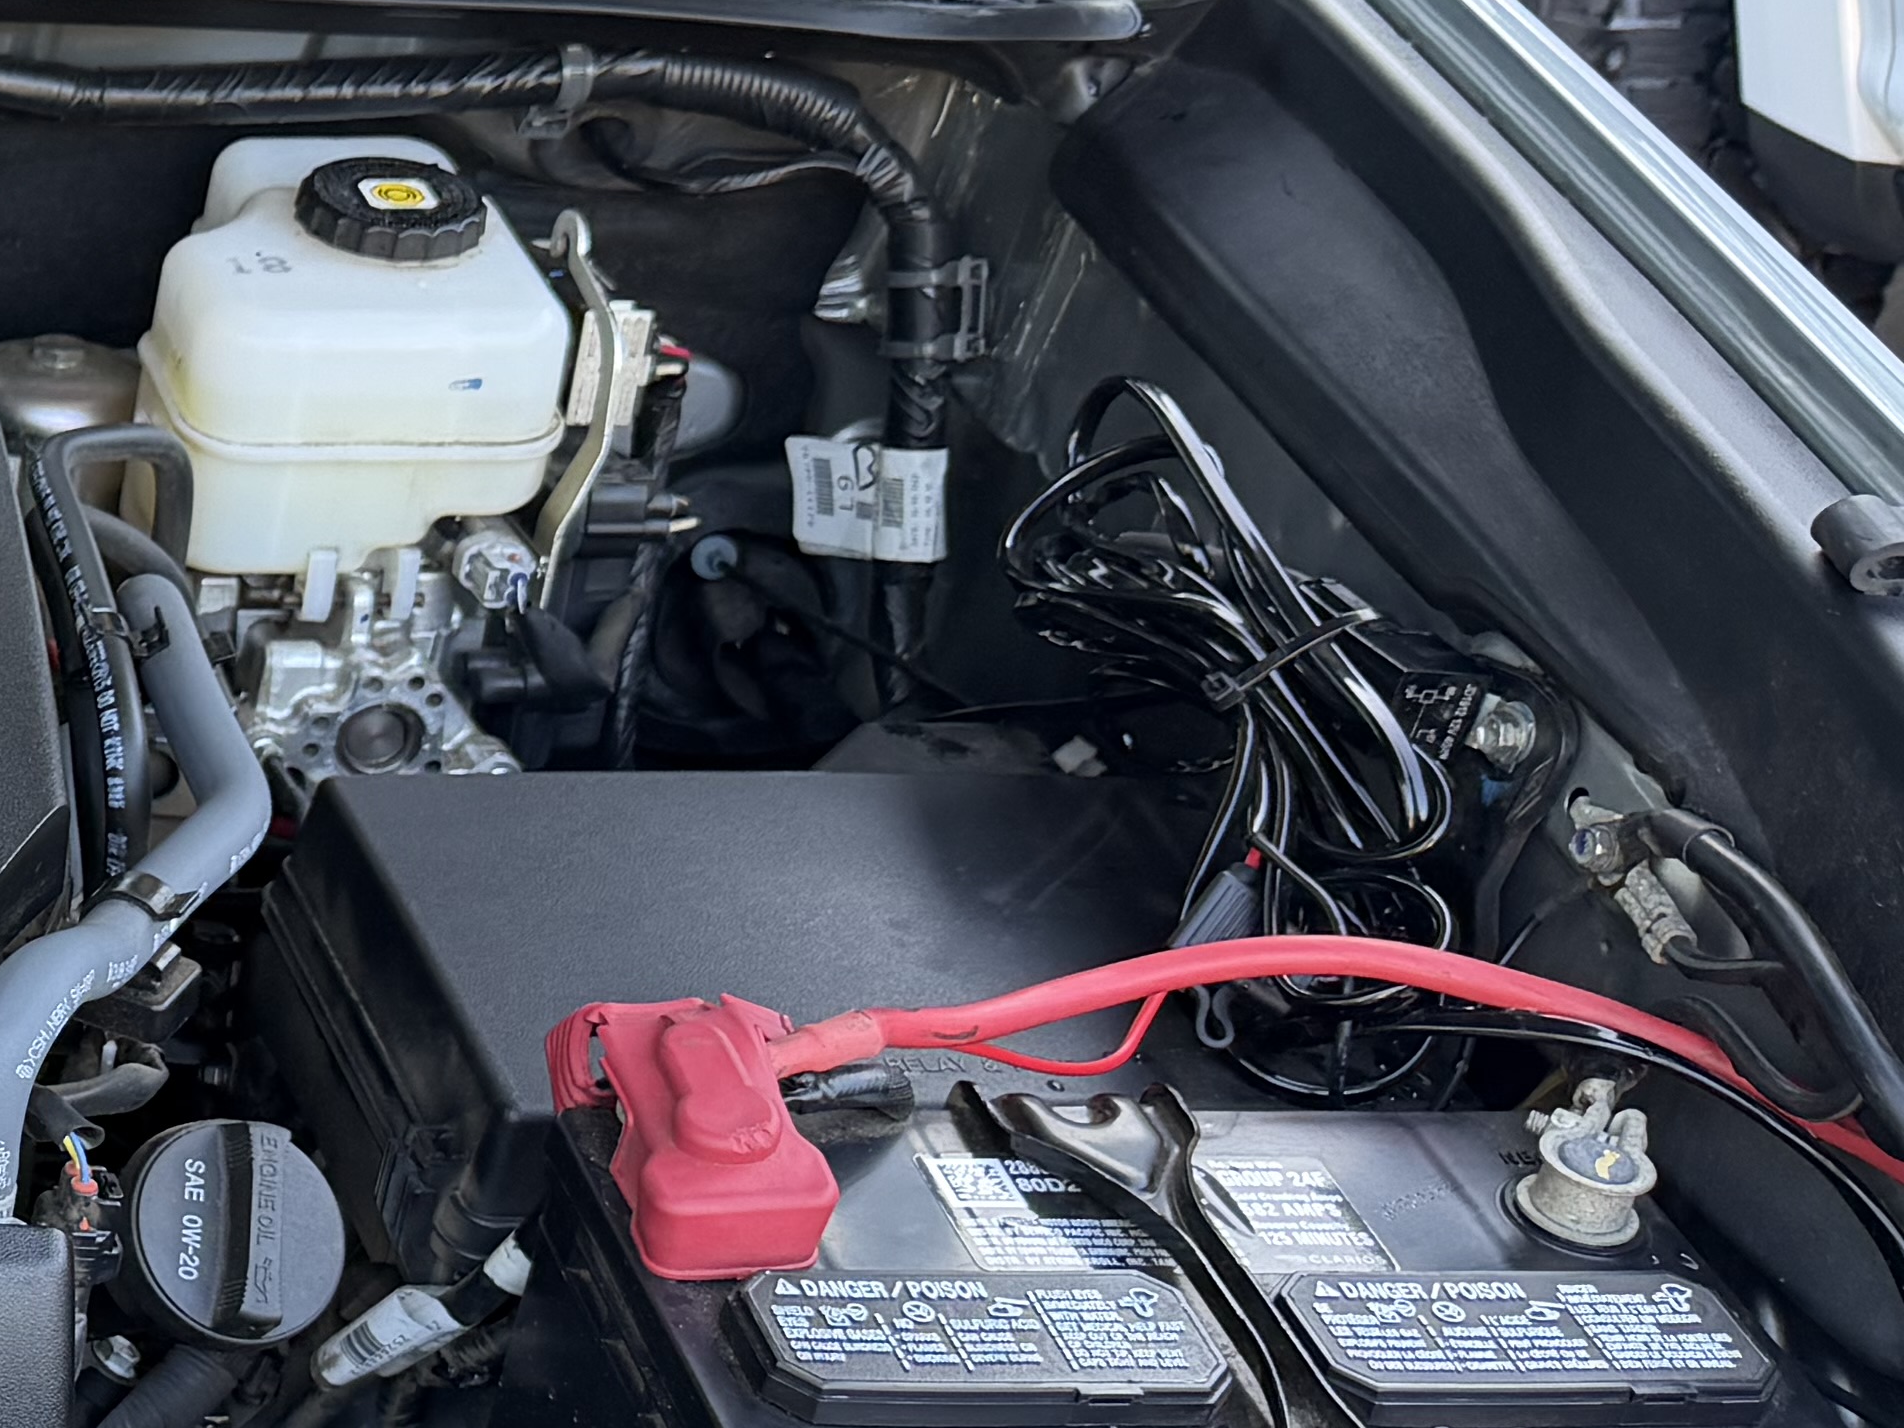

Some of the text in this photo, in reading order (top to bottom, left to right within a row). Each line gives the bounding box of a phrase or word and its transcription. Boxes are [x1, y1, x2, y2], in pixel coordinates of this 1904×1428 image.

[1498, 1150, 1544, 1167] NE
[1215, 1170, 1328, 1188] GROUP 24F
[256, 1133, 279, 1246] ENGINE OIL
[1281, 1202, 1342, 1217] AMPS
[177, 1158, 206, 1281] SAE 0W-20
[1292, 1230, 1375, 1246] MINUTES
[1308, 1254, 1388, 1266] CLARIOS
[800, 1279, 889, 1298] DANGER
[905, 1280, 988, 1299] POISON
[1339, 1281, 1428, 1300] DANGER
[1442, 1281, 1527, 1300] POISON
[893, 1318, 914, 1329] NO
